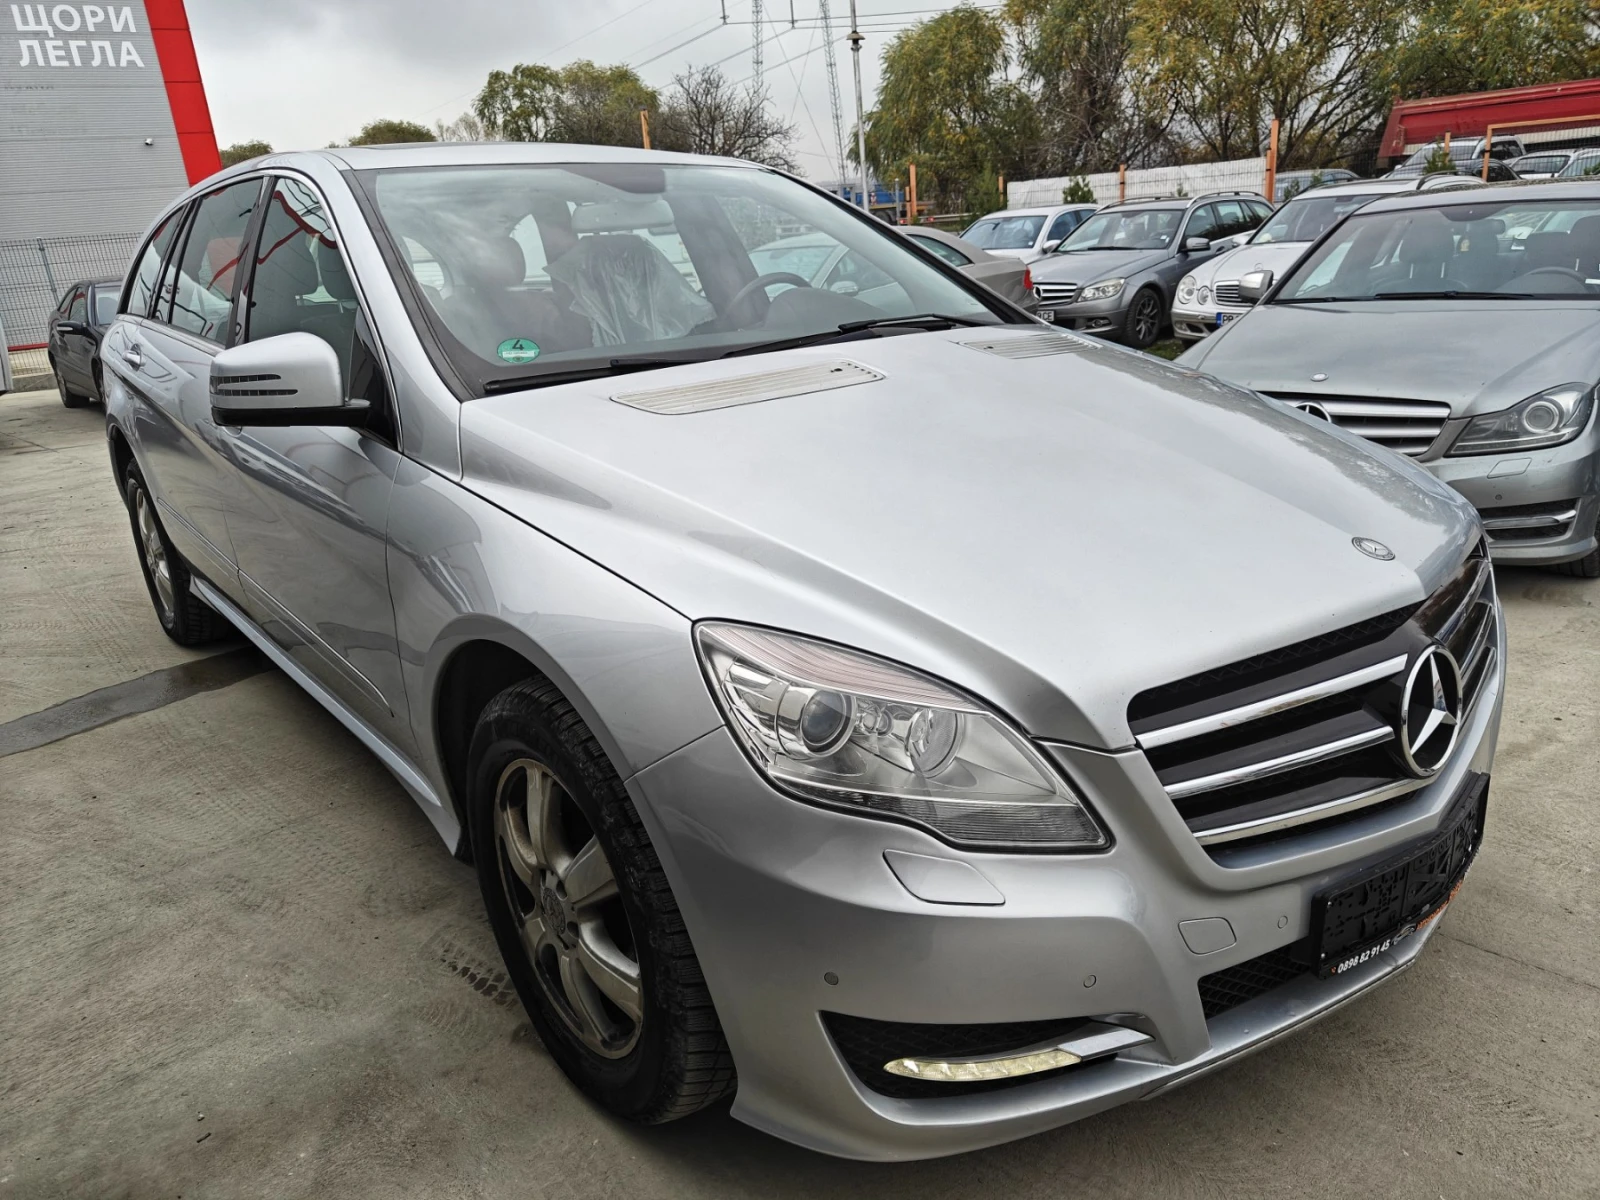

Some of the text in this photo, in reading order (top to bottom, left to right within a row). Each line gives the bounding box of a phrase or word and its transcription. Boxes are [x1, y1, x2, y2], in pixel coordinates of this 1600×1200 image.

[10, 4, 137, 38] ЩОРИ
[19, 39, 145, 68] ЛЕГЛА
[512, 339, 525, 351] 4
[1337, 939, 1391, 974] 0898 82 91 45
